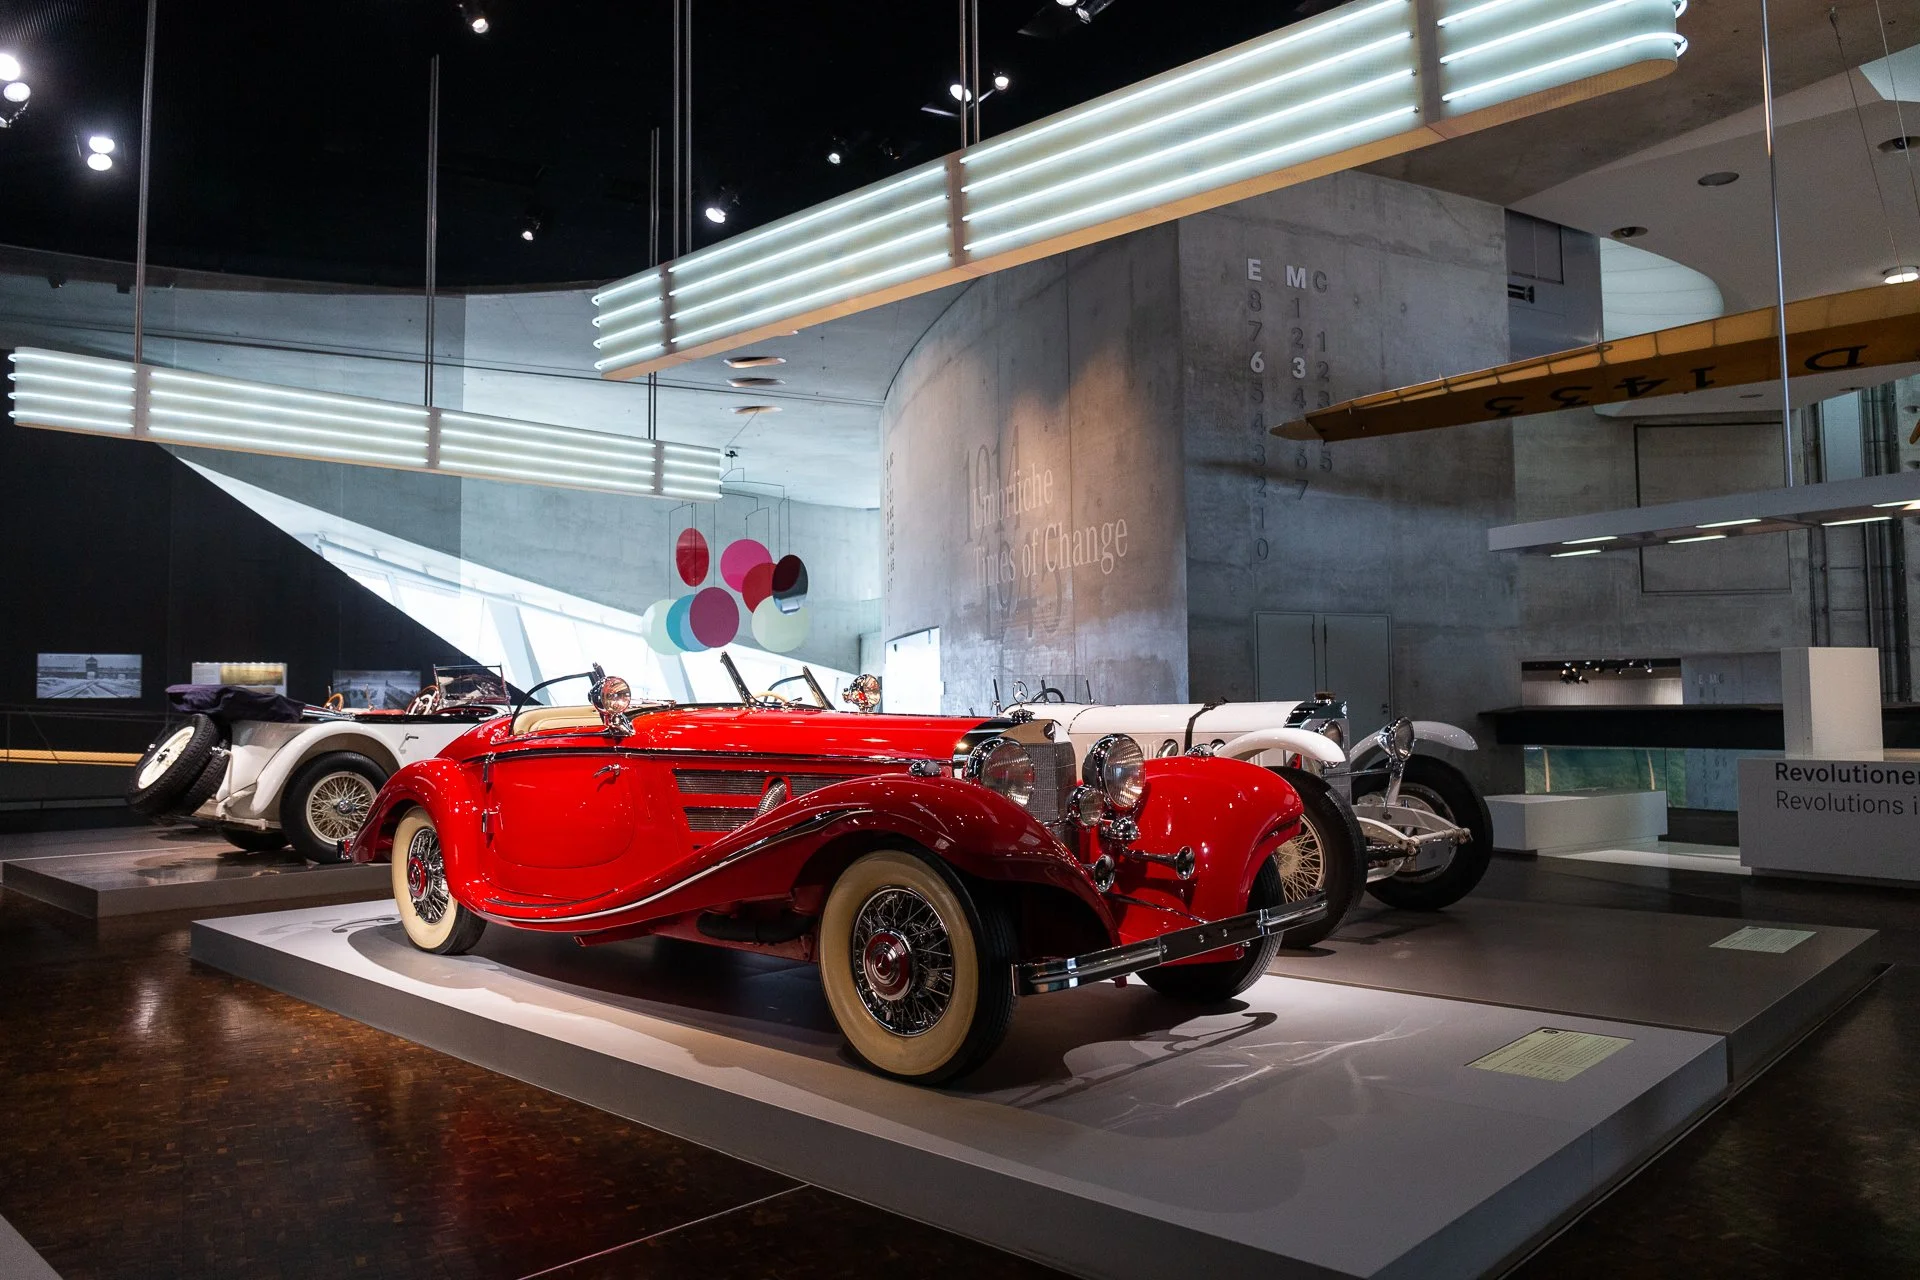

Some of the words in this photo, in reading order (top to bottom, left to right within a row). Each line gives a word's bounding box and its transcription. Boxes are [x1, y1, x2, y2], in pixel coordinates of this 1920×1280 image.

[1247, 257, 1262, 281] E
[1247, 289, 1262, 312] 8
[1247, 320, 1263, 342] 7
[1291, 326, 1304, 349] 2
[1250, 351, 1265, 373] 6
[1292, 357, 1306, 379] 3
[1316, 361, 1330, 383] 2
[1804, 344, 1868, 371] D
[972, 463, 1054, 531] Umbrüche
[1295, 479, 1309, 501] 7
[973, 545, 1017, 588] Times
[1021, 528, 1039, 578] of
[1044, 519, 1128, 575] Change
[1775, 762, 1920, 785] Revolutione
[1776, 790, 1904, 815] Revolutions
